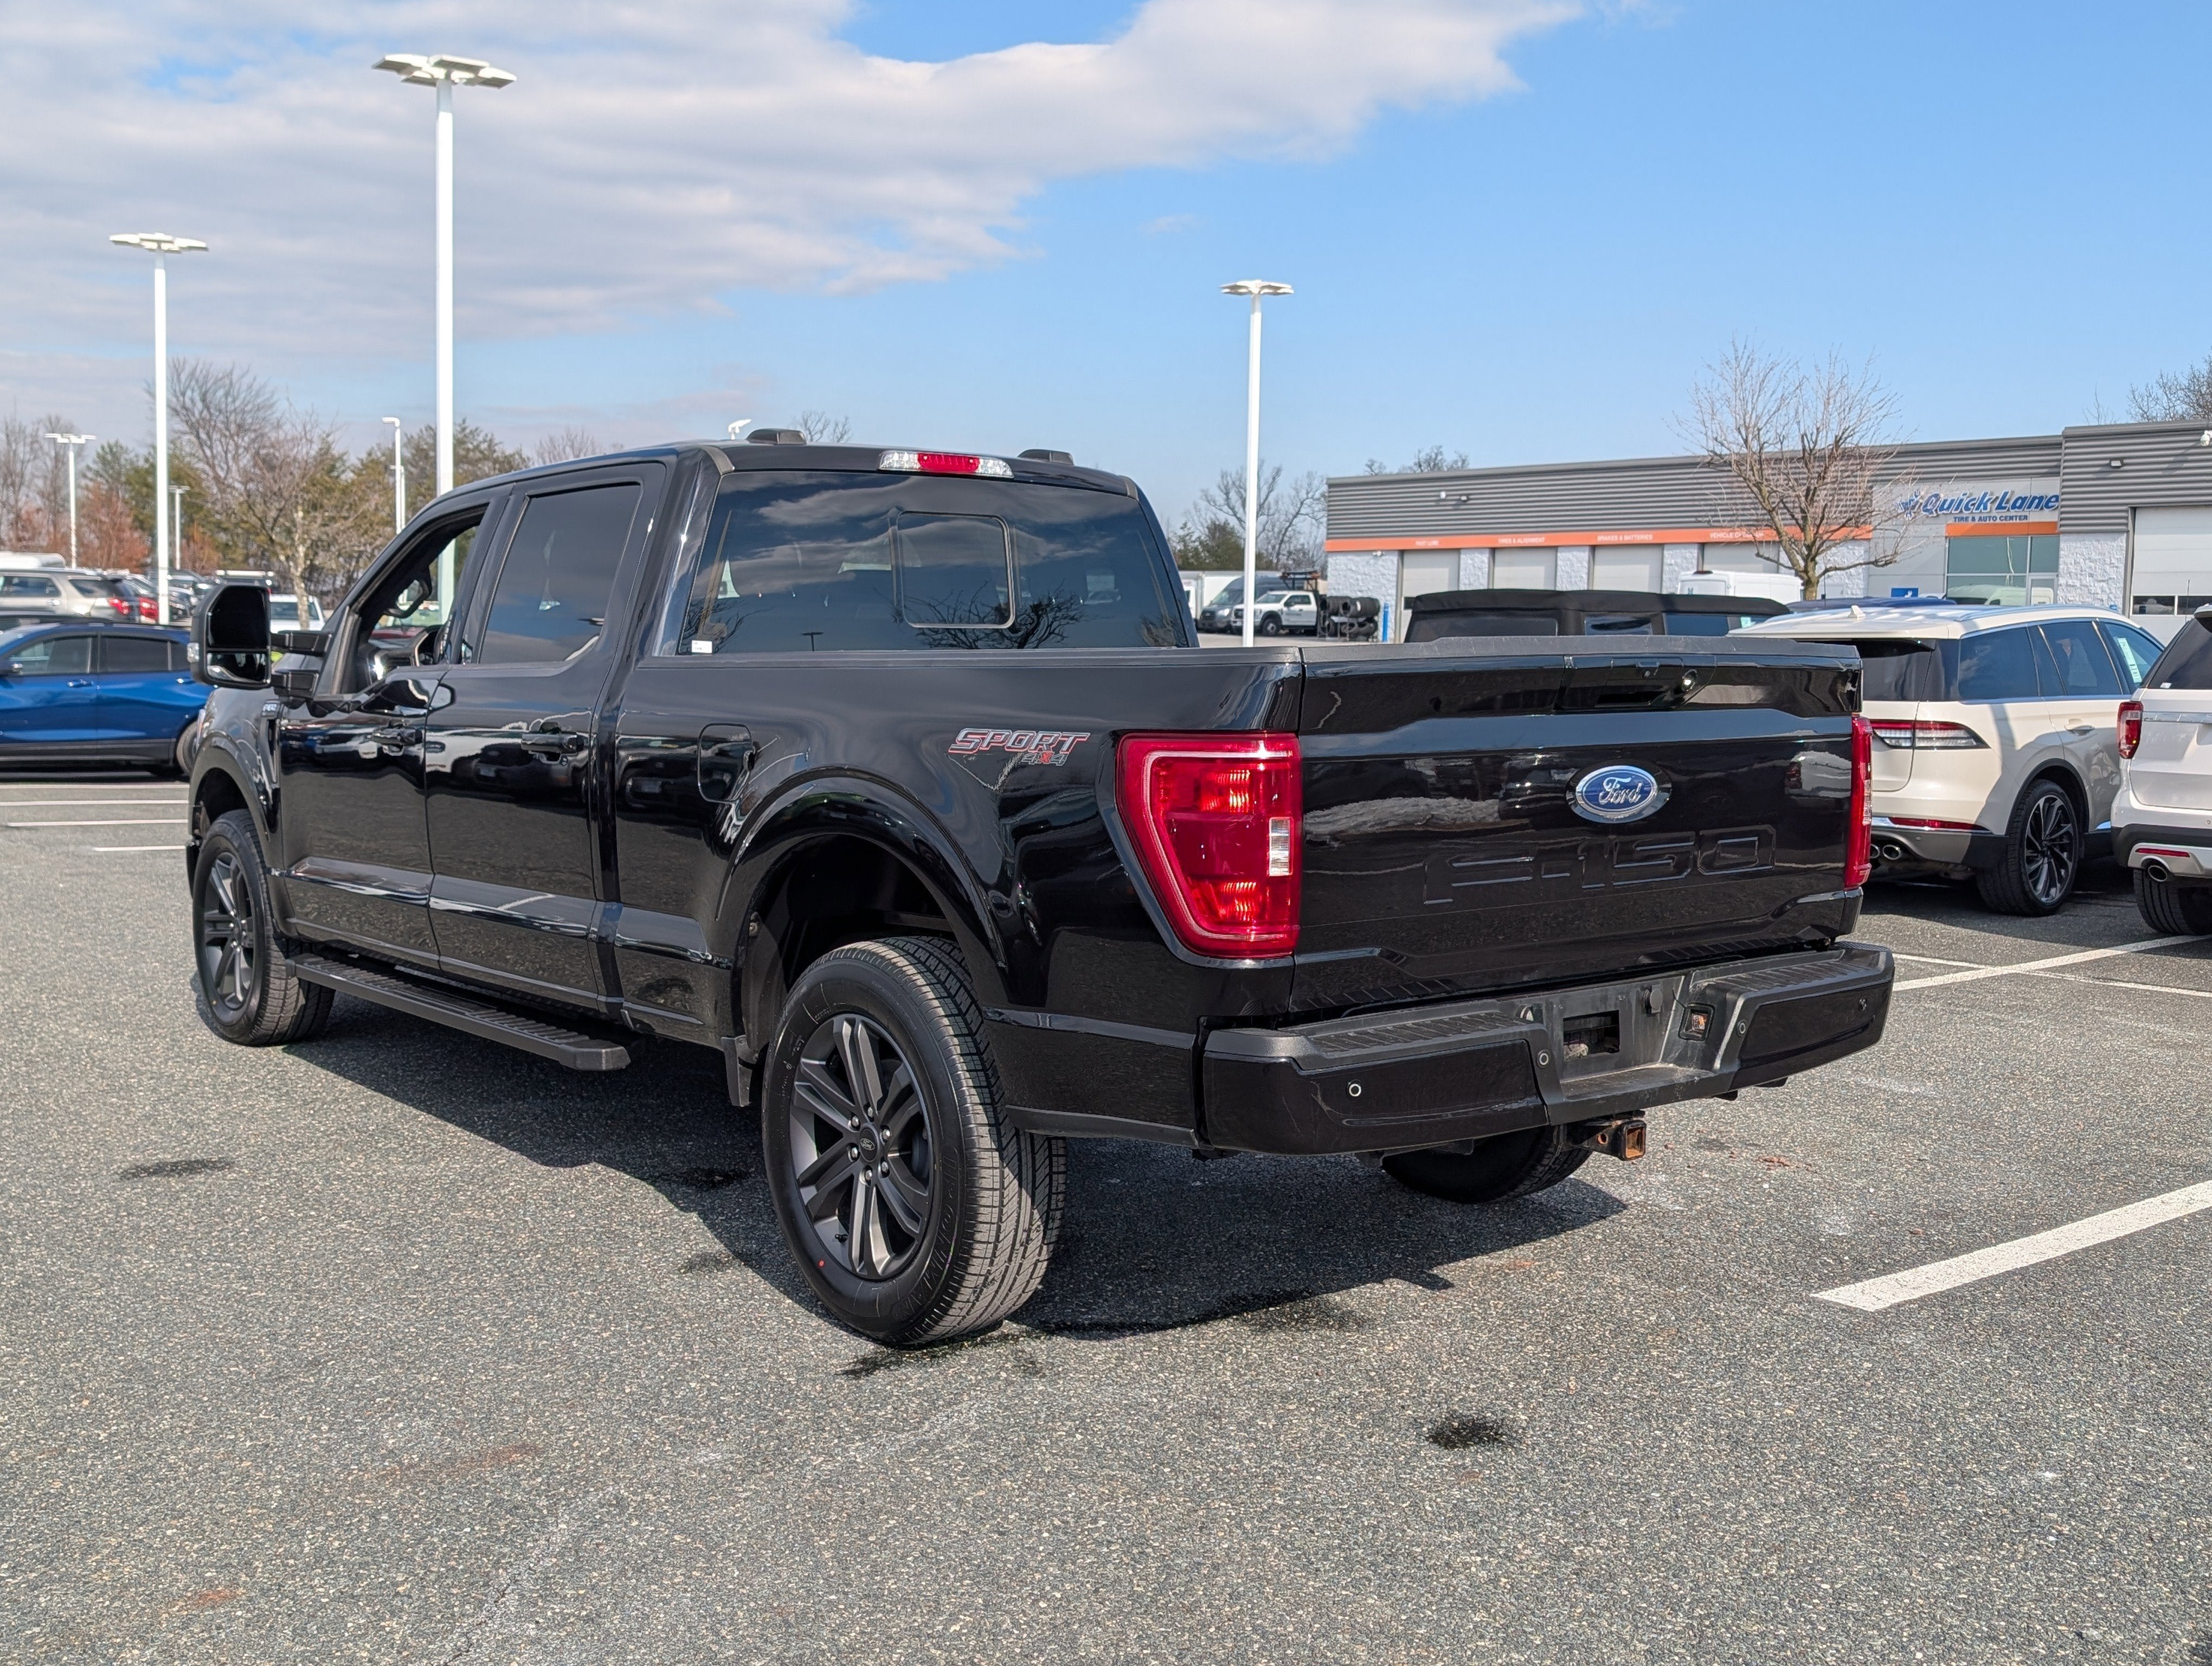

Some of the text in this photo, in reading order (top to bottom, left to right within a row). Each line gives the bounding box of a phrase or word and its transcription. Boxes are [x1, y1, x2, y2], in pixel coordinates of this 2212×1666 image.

[1922, 490, 2060, 516] Quick Lane
[948, 728, 1090, 754] SPORT
[1599, 777, 1641, 805] Ford
[1424, 824, 1776, 904] F-150
